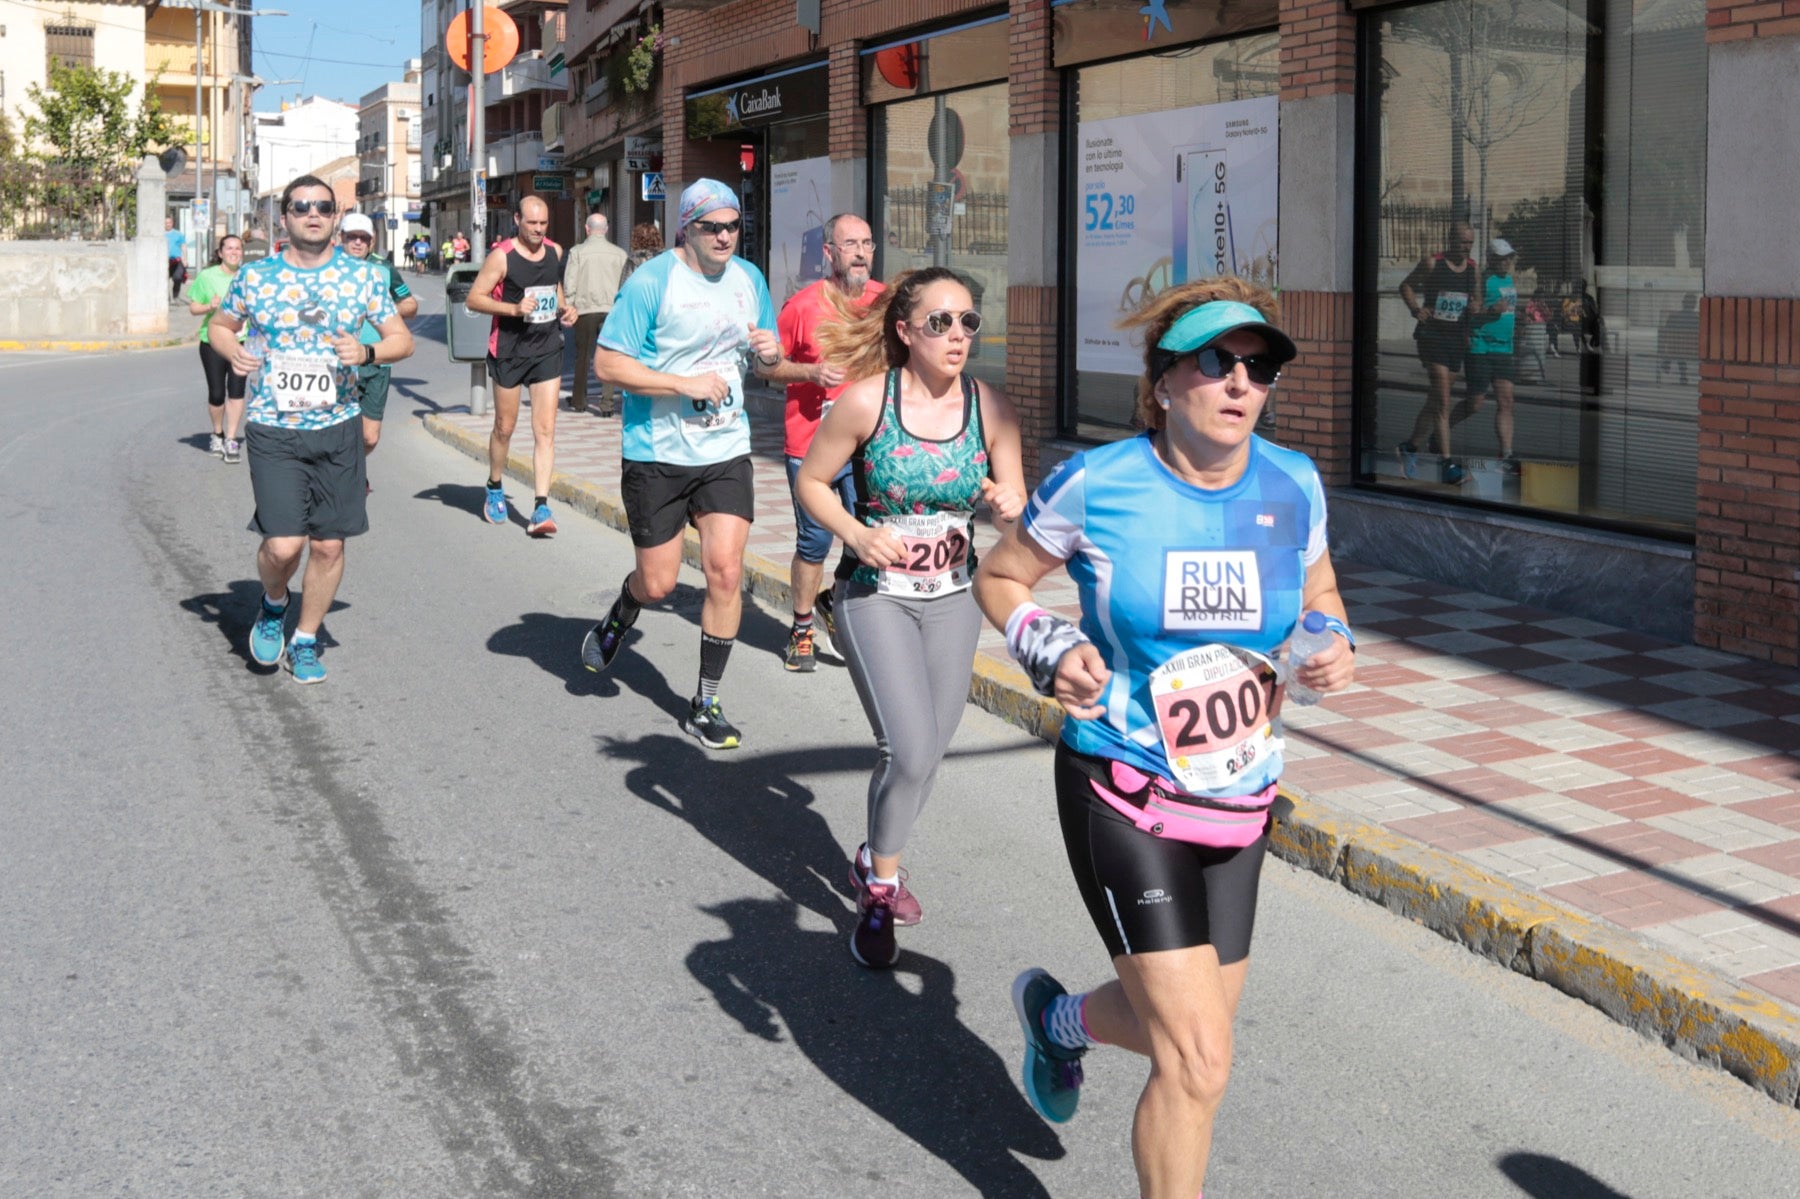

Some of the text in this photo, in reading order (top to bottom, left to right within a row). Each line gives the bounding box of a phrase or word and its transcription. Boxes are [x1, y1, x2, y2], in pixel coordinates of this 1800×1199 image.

[740, 86, 781, 114] CaixaBank
[1085, 152, 1096, 161] con
[1097, 150, 1103, 160] lo
[1085, 165, 1093, 173] en
[1214, 161, 1226, 275] ote10+ 5G
[277, 371, 330, 392] 3070
[1182, 561, 1245, 585] RUN
[1181, 586, 1247, 611] RUN
[1186, 651, 1213, 669] GRAN
